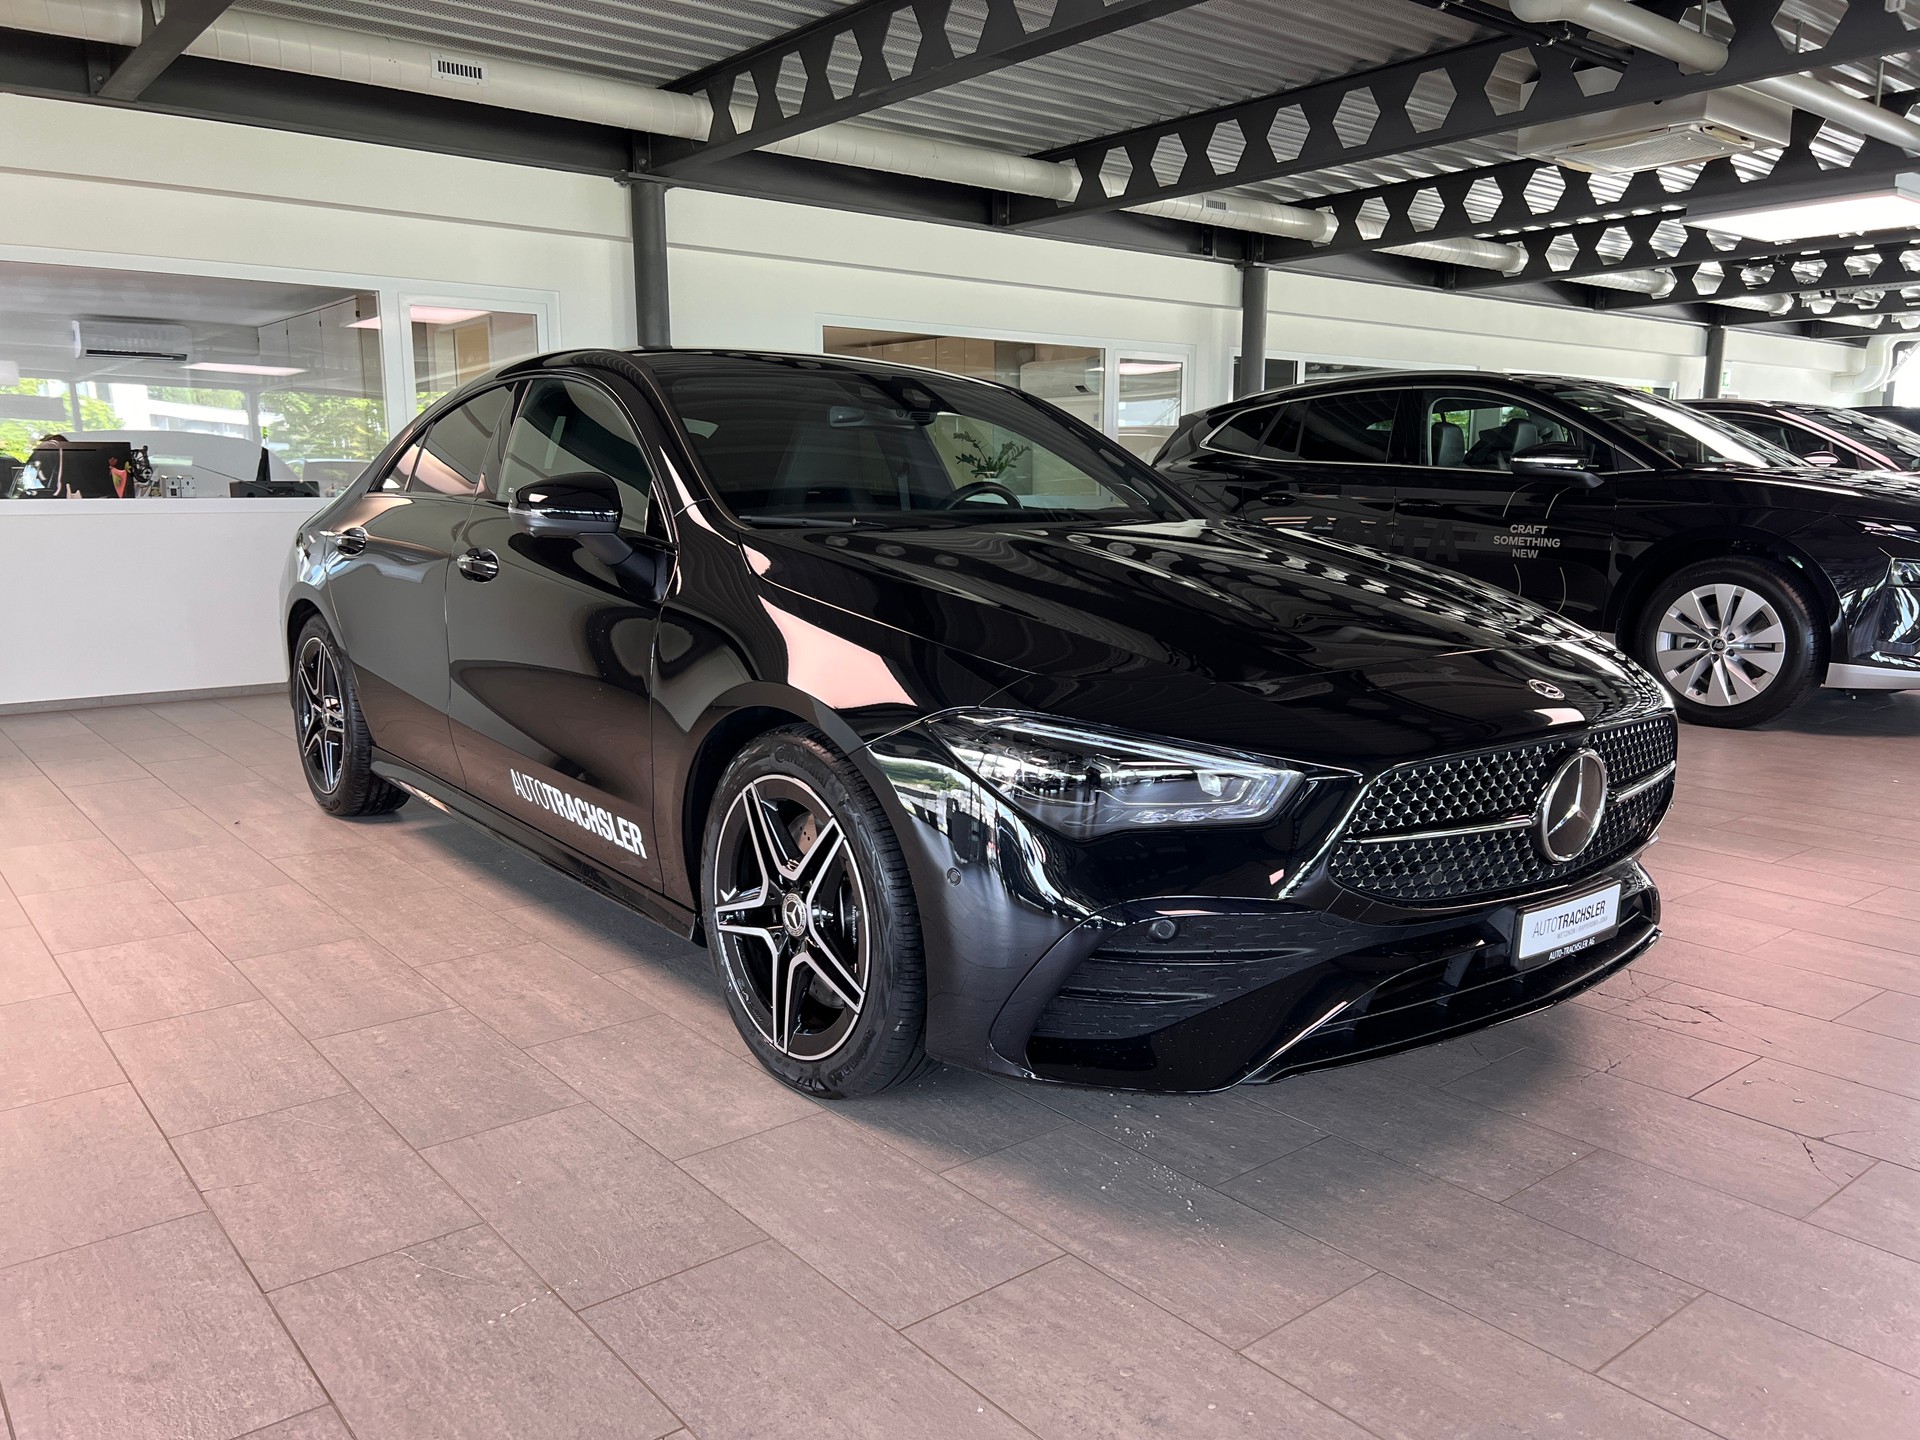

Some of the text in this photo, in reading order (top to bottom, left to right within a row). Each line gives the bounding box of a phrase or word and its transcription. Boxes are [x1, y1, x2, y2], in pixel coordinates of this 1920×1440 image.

[1510, 524, 1548, 535] CRAFT
[1493, 535, 1561, 548] SOMETHING
[1512, 548, 1539, 559] NEW
[510, 768, 647, 860] AUTOTRACHSLER
[1532, 900, 1606, 939] AUTOTRACHSLER
